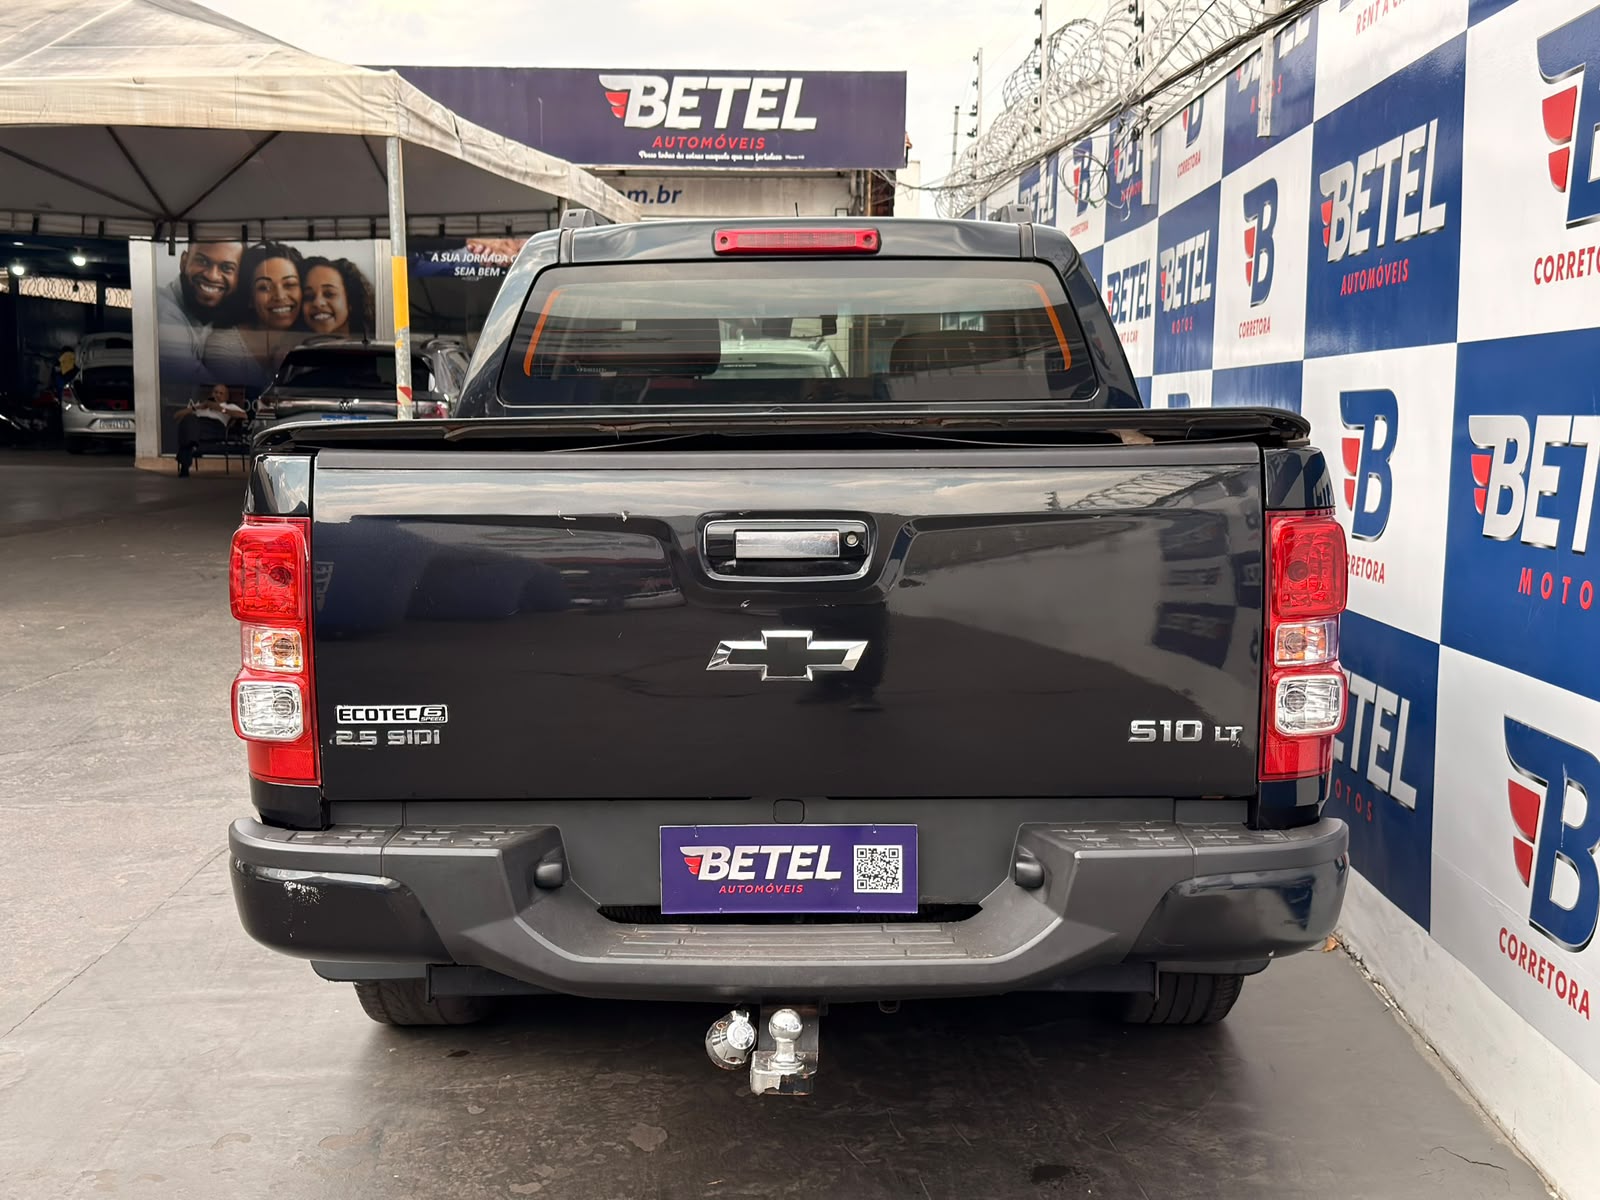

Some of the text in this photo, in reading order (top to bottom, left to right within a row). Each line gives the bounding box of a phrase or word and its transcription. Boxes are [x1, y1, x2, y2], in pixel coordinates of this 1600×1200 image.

[599, 75, 817, 129] BETEL
[652, 134, 766, 149] AUTOMÓVEIS
[1319, 118, 1447, 264] BETEL
[431, 253, 439, 262] A
[440, 253, 460, 262] SUA
[462, 253, 508, 263] JORNADA
[454, 267, 500, 277] SEJA BEM
[1160, 229, 1212, 312] BETEL
[1107, 258, 1152, 324] BETEL
[1340, 258, 1409, 297] AUTOMÓVEIS
[1172, 315, 1193, 335] MOTOS
[1239, 317, 1271, 339] CORRETORA
[1468, 415, 1600, 555] BET
[1347, 553, 1384, 585] RETORA
[1518, 567, 1594, 610] MOTO
[339, 708, 417, 721] ECOTEC
[1128, 720, 1243, 742] S10 LT
[387, 729, 440, 745] SIDI
[1334, 668, 1417, 811] TEL
[1334, 778, 1373, 823] OTOS
[680, 845, 842, 881] BETEL
[719, 883, 804, 895] AUTOMÓVEIS
[1499, 927, 1590, 1021] CORRETORA
